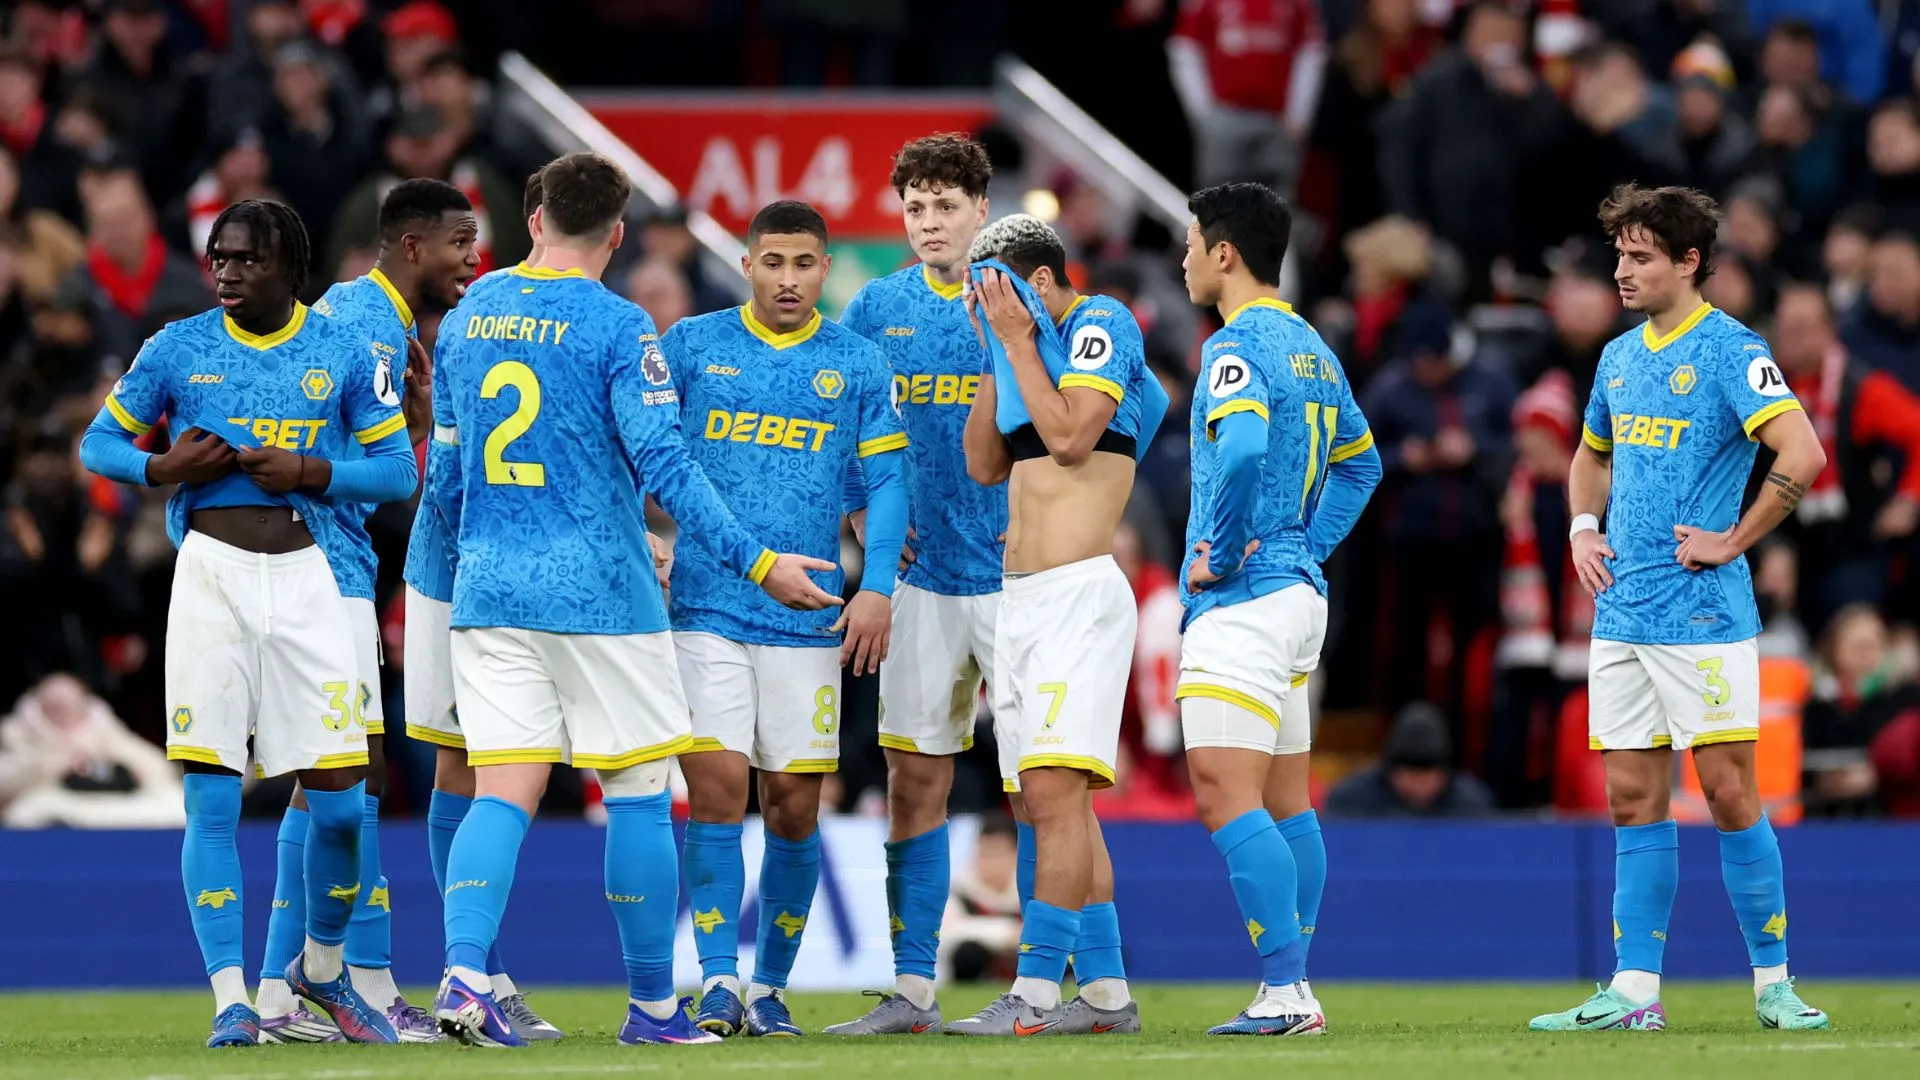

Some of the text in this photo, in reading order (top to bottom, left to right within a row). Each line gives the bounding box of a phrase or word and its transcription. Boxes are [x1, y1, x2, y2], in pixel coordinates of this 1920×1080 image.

[466, 315, 570, 345] DOHERTY
[884, 327, 915, 337] SUDU
[1075, 336, 1107, 359] JD
[189, 374, 224, 384] SUDU
[704, 364, 741, 376] SUDU
[1214, 365, 1243, 391] JD
[1289, 354, 1316, 379] HEE
[1759, 366, 1783, 391] JD
[642, 389, 676, 400] No room
[480, 360, 545, 487] 2
[704, 409, 834, 452] DEBET
[1298, 401, 1339, 520] 11
[1696, 656, 1731, 707] 3
[812, 685, 837, 735] 8
[1037, 682, 1067, 731] 7
[1703, 711, 1736, 722] SUDU
[1033, 735, 1066, 745] SUDU
